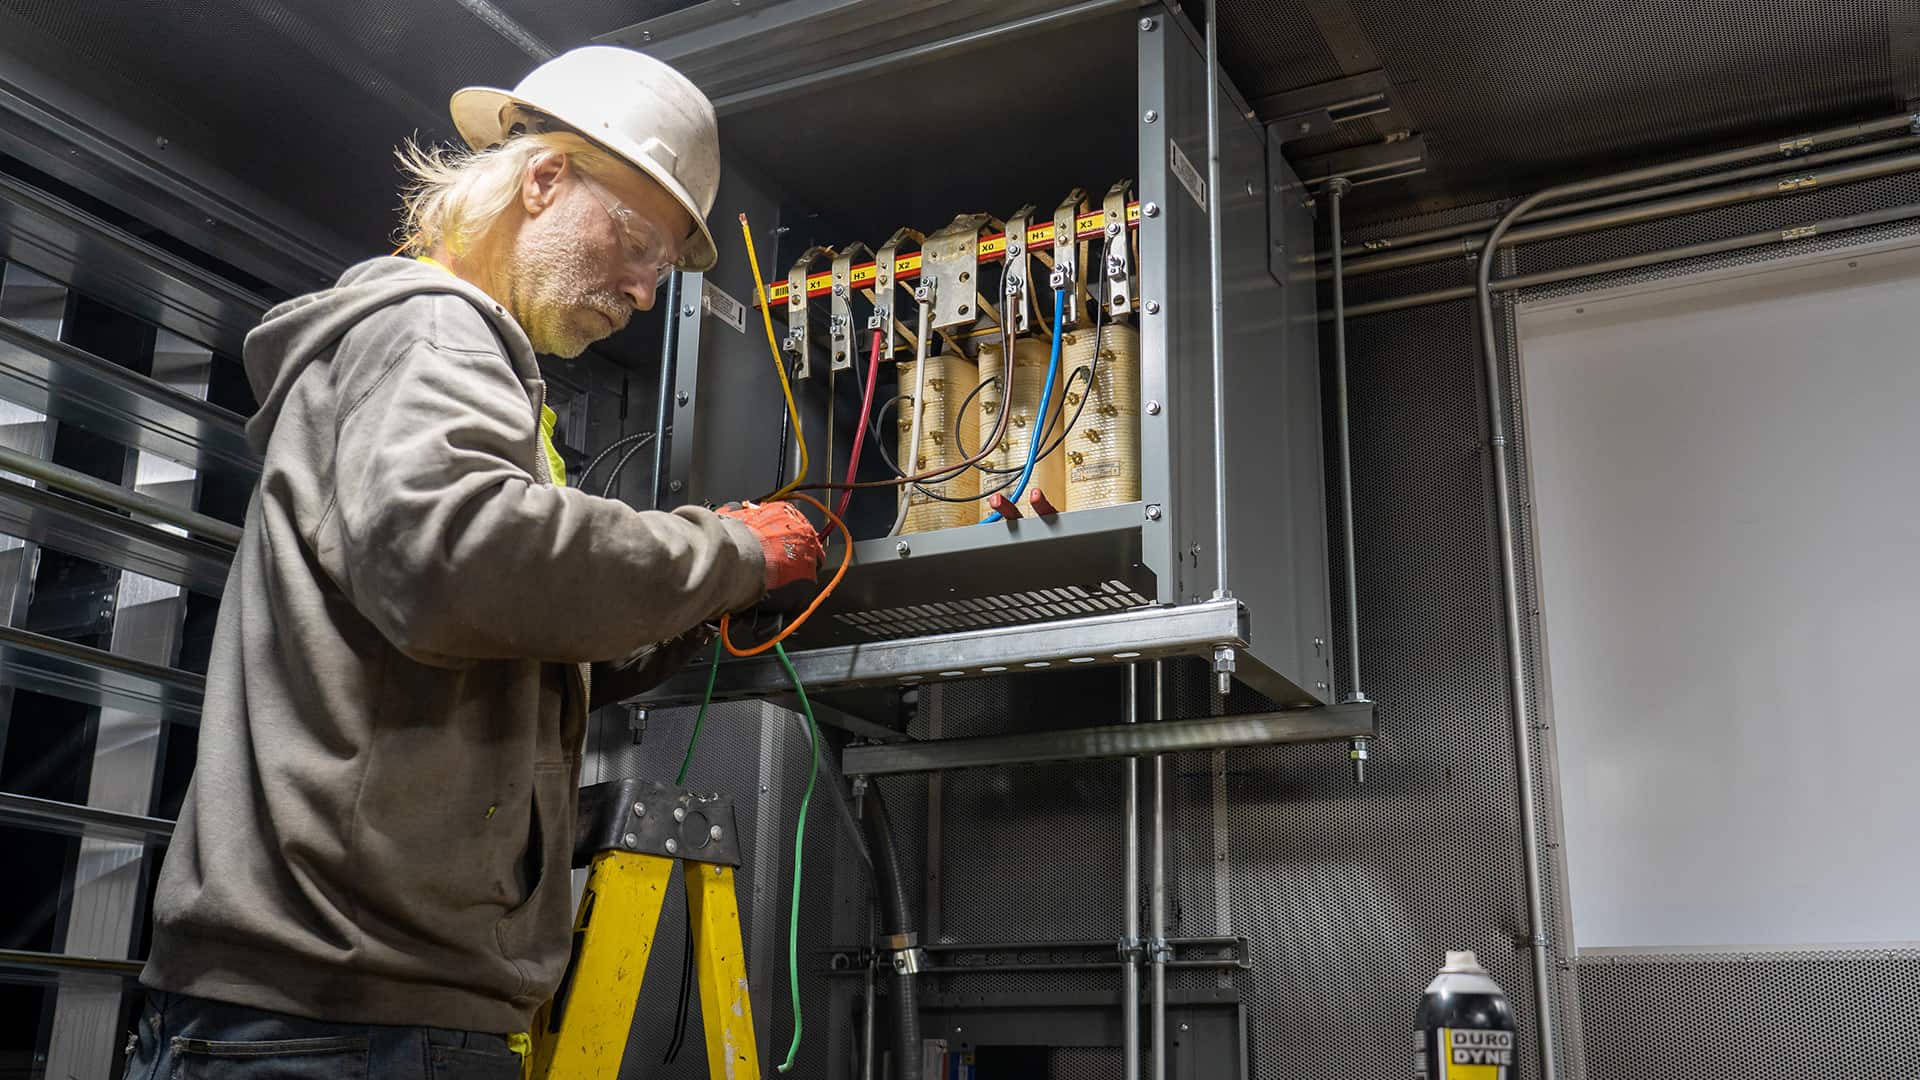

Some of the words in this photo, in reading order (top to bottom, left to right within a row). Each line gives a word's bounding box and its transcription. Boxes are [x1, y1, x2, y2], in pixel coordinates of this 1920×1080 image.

[1080, 220, 1093, 229] X3
[1032, 232, 1044, 240] H1
[898, 262, 910, 270] X2
[854, 272, 866, 280] H3
[810, 281, 821, 289] X1
[1455, 1032, 1510, 1045] DURO
[1453, 1050, 1512, 1064] DYNE
